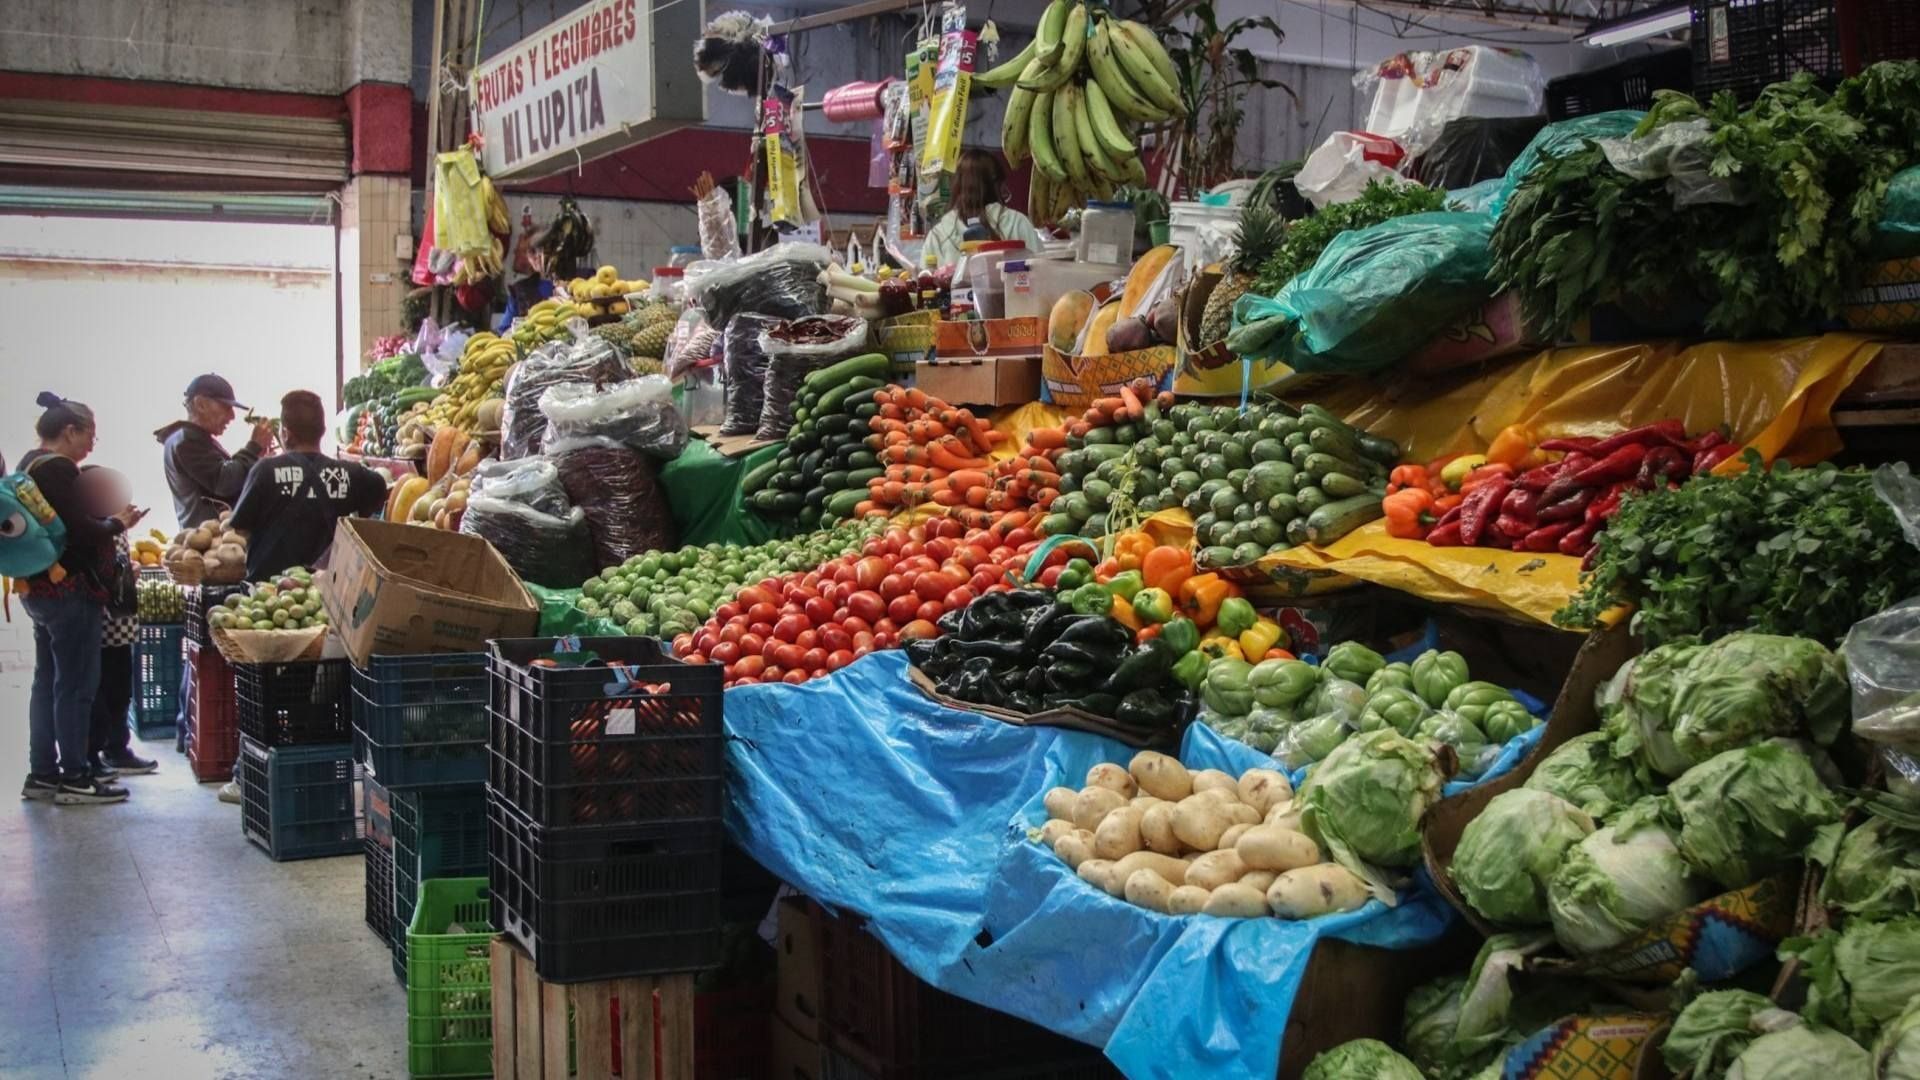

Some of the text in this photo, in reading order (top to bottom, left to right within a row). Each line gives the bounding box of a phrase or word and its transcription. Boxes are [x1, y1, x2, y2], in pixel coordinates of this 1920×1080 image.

[477, 0, 636, 115] FRUTAS Y LEGUMBRES
[502, 67, 605, 165] MI LUPITA
